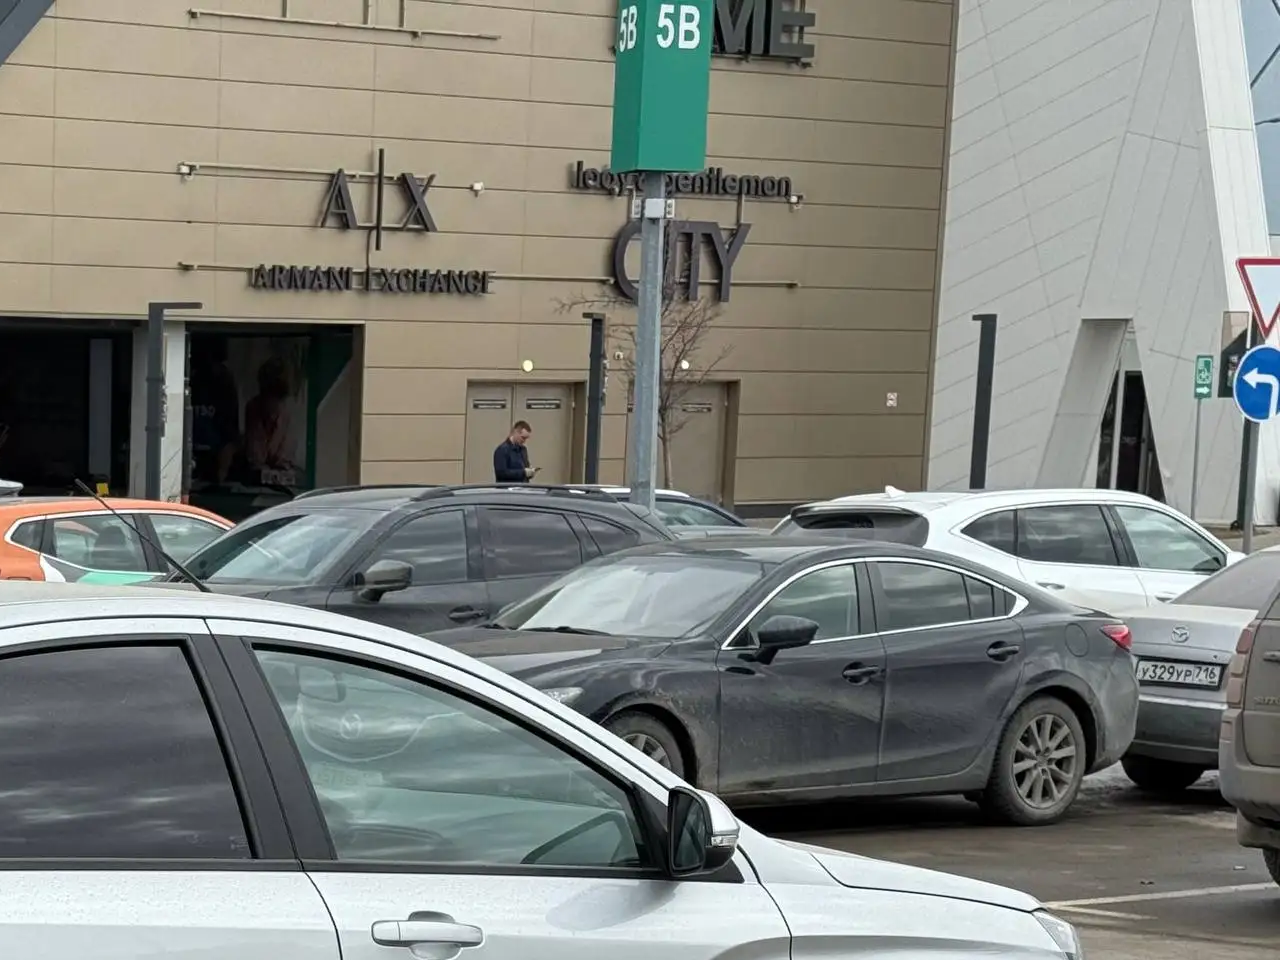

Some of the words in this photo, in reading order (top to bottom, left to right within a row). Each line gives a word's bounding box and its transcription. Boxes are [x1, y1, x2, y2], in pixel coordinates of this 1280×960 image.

[619, 5, 638, 52] 5B
[656, 4, 701, 50] 5B
[711, 0, 816, 58] ME
[248, 264, 353, 292] ARMANI
[364, 266, 496, 295] EXCHANGE
[613, 219, 752, 304] CITY
